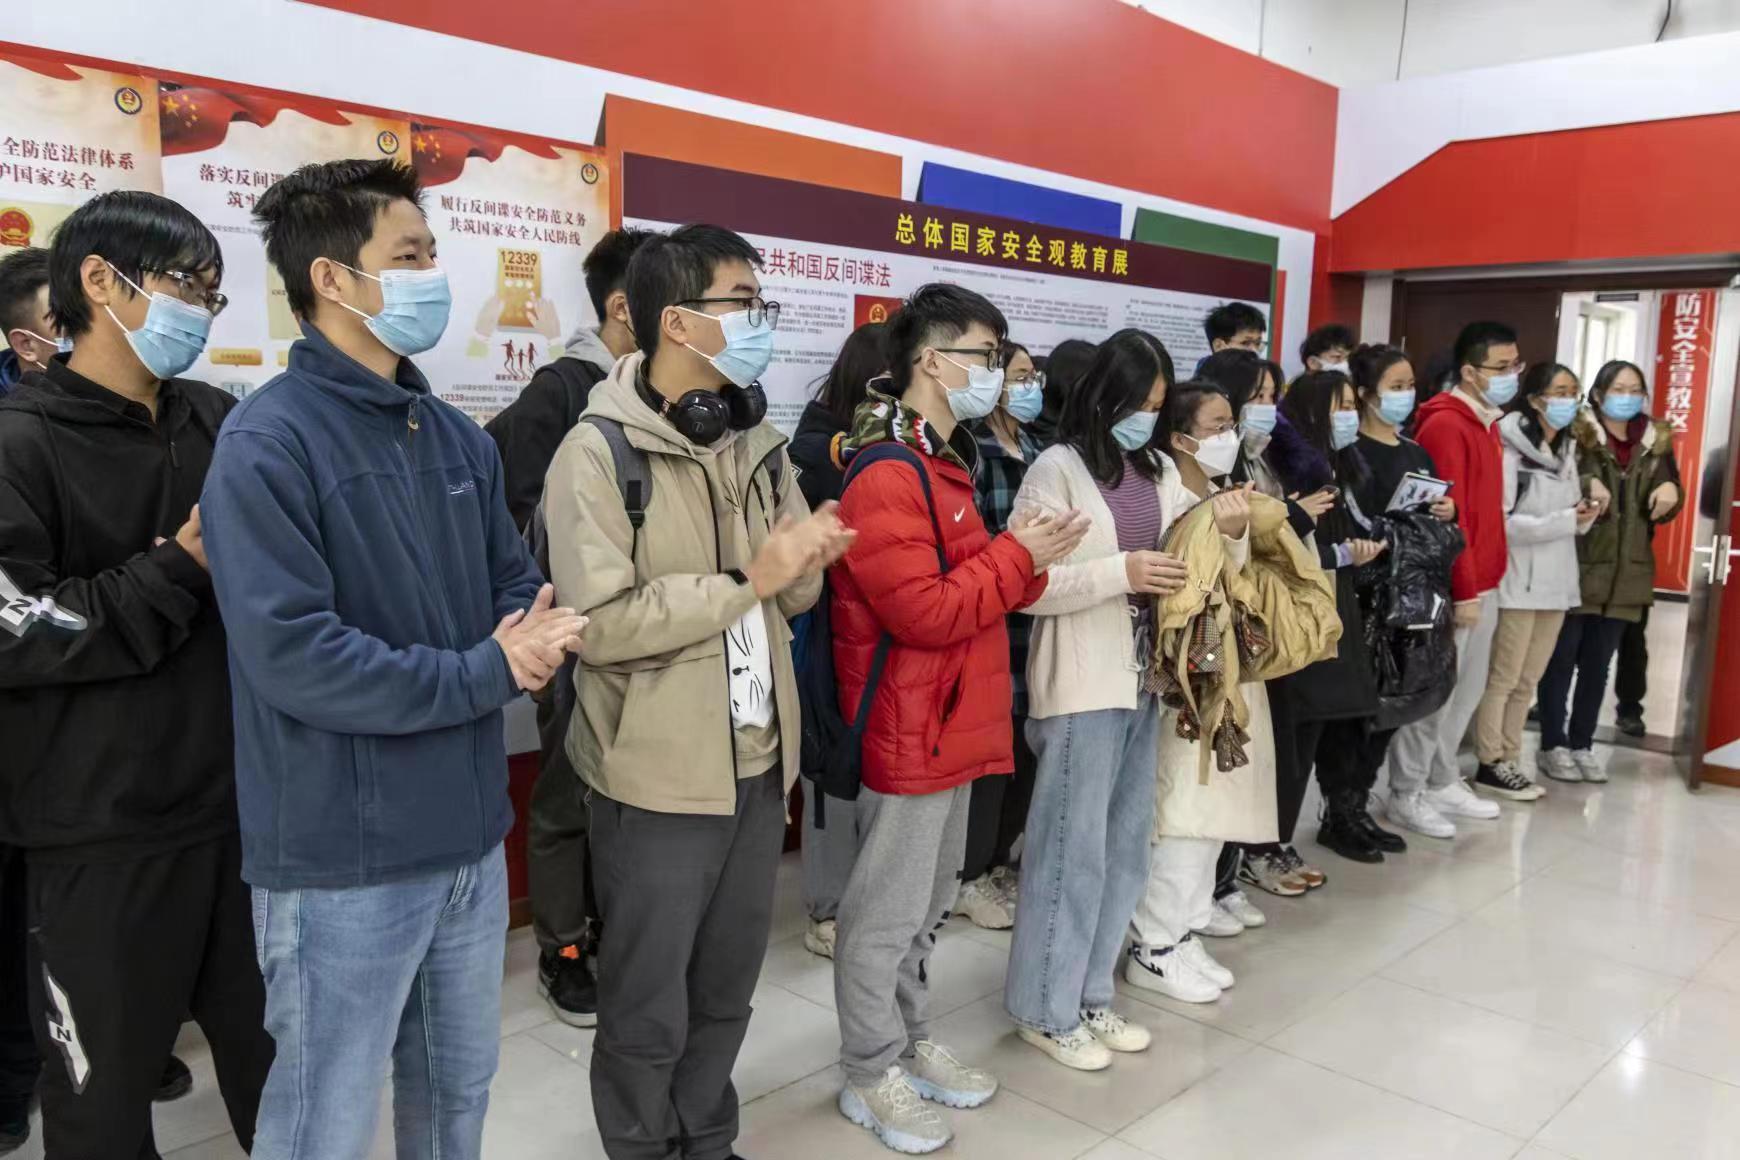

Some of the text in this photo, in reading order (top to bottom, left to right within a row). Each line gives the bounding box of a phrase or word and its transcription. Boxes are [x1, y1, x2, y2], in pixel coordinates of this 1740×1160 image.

[3, 136, 135, 170] 全防范法律体系
[441, 195, 586, 226] 履行反间谍安全防范义务
[450, 216, 582, 246] 共筑国家安全人民防线
[896, 213, 1128, 276] 总体国家安全观教育展
[501, 251, 538, 266] 12339
[1665, 292, 1701, 433] 防安全宣教区
